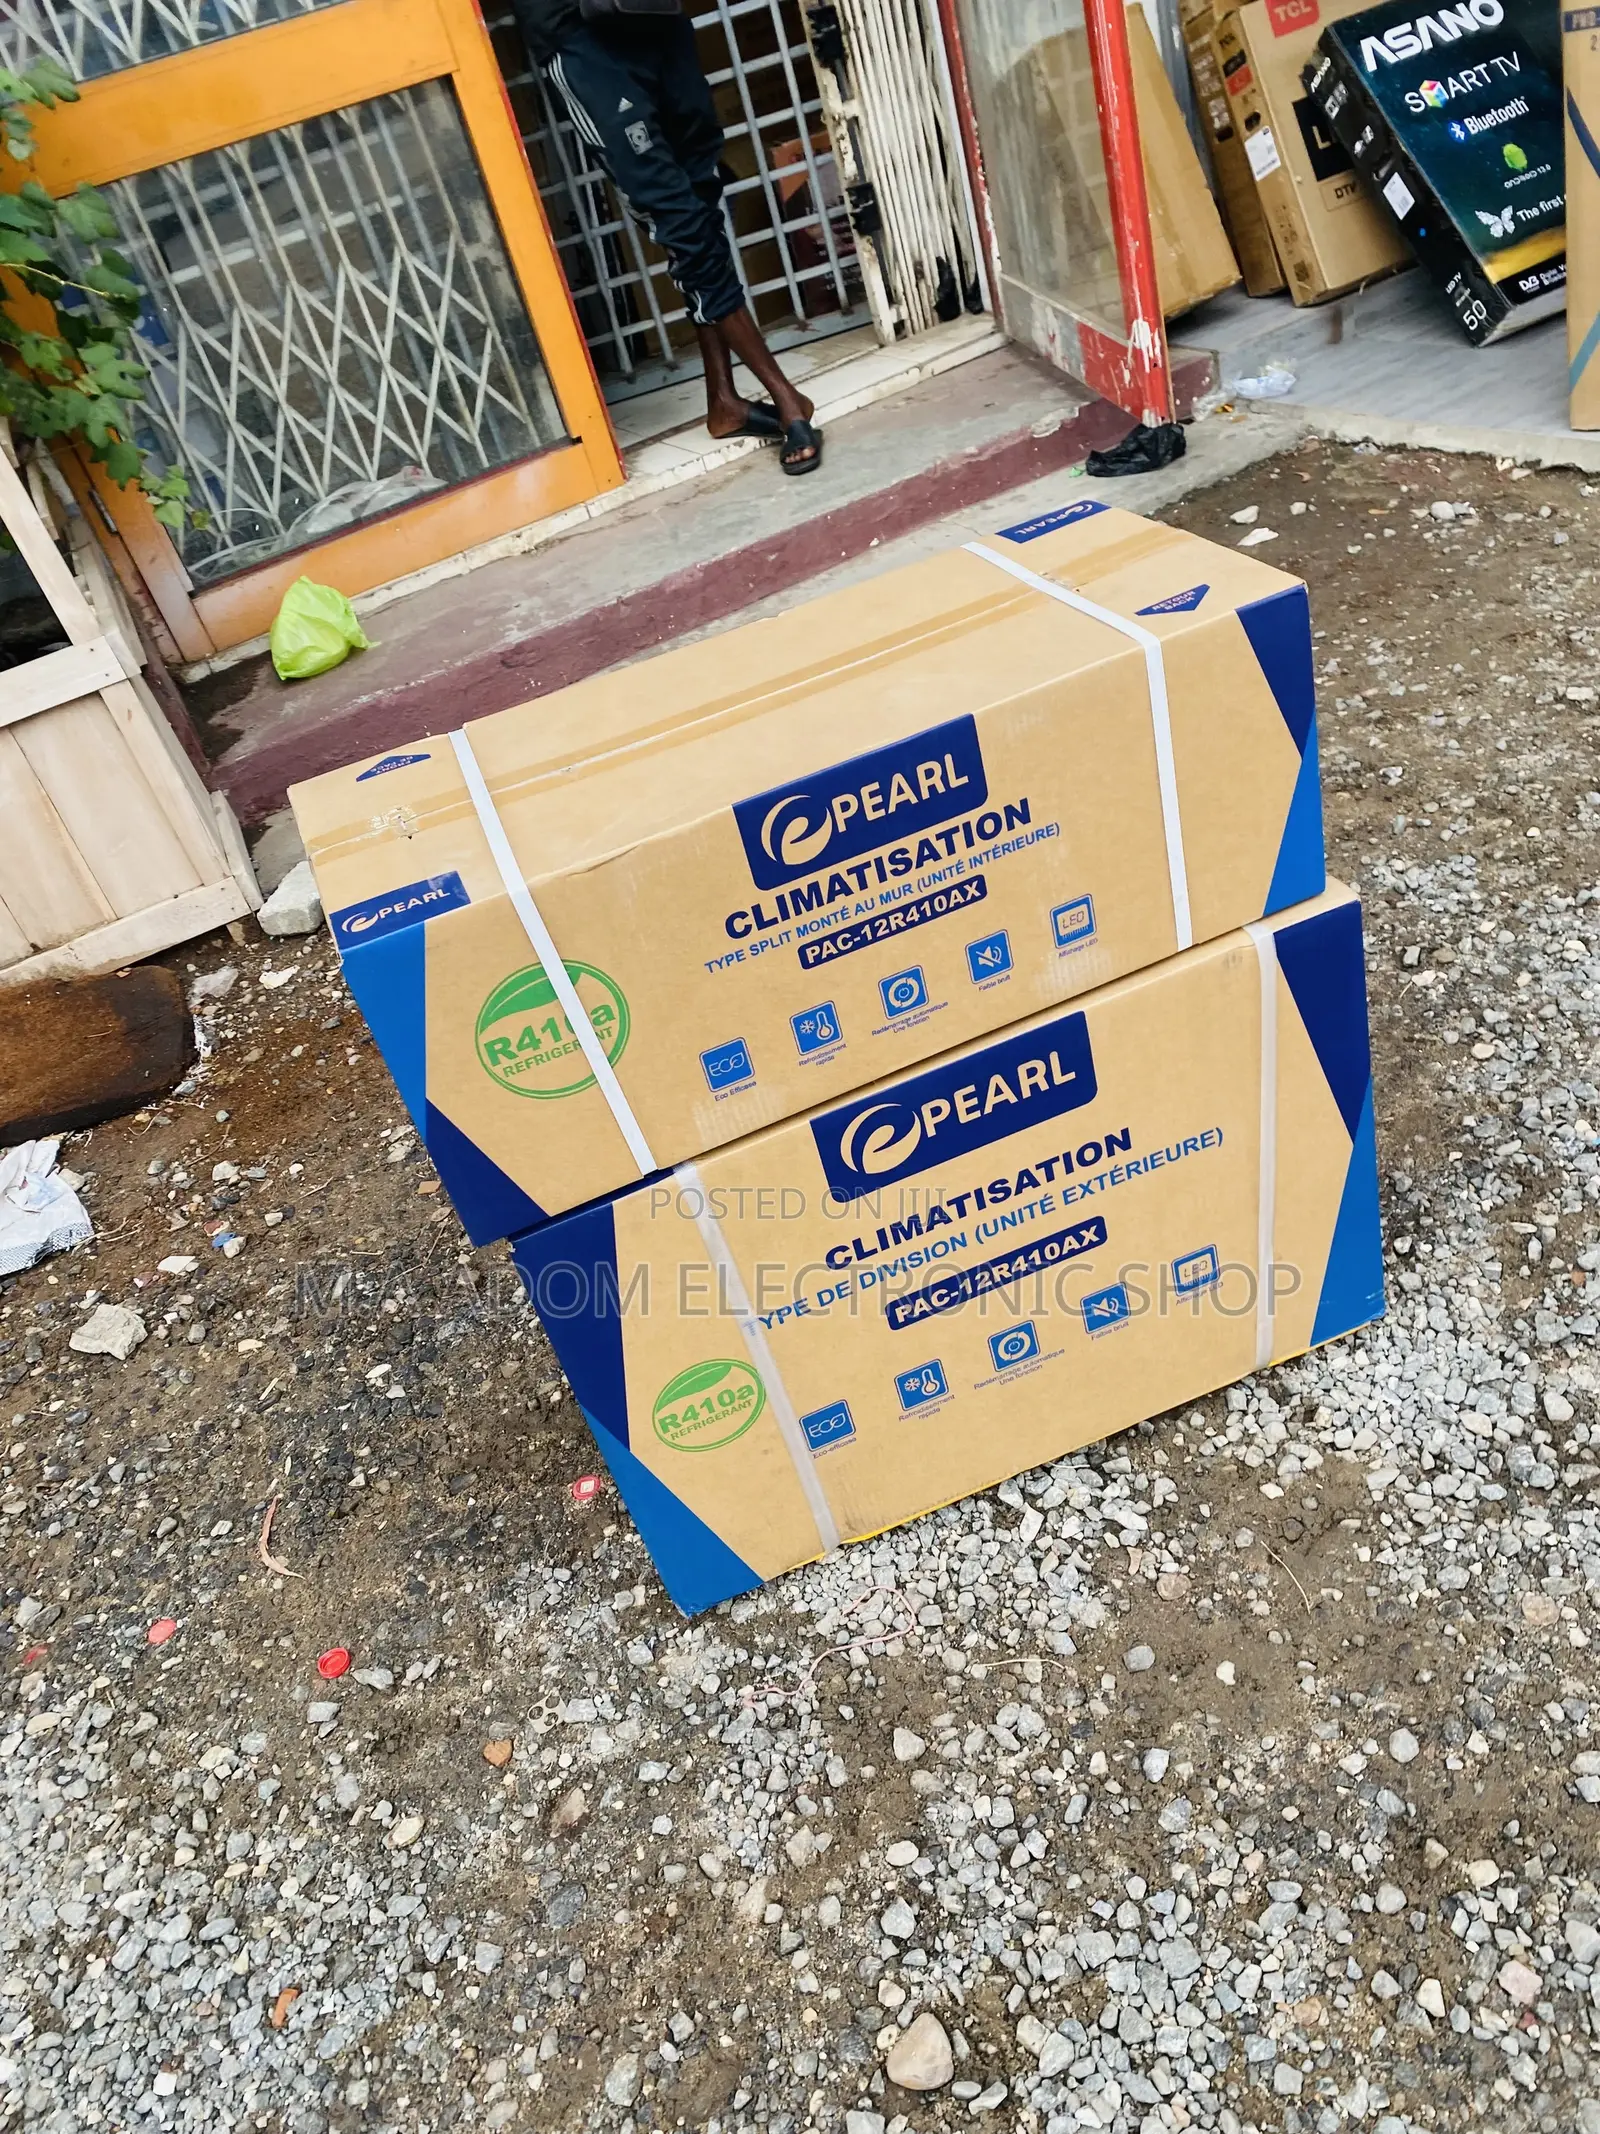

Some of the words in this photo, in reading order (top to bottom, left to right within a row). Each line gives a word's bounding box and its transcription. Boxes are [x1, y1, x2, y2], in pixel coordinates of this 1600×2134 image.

[1273, 0, 1312, 22] TCL
[1359, 0, 1504, 72] ASANO
[1490, 50, 1521, 77] TV
[1463, 96, 1530, 135] Bluetooth
[1516, 207, 1540, 222] The
[1539, 194, 1564, 212] first
[1462, 299, 1487, 331] 50
[1014, 513, 1068, 535] PEARL
[1151, 590, 1196, 611] RETOUR
[1164, 597, 1195, 611] BACK
[831, 752, 969, 834] PEARL
[724, 797, 1032, 940] CLIMATISATION
[376, 887, 451, 921] PEARL
[704, 948, 748, 975] TYPE
[749, 929, 793, 957] SPLIT
[795, 905, 851, 939] MONTÉ
[854, 894, 877, 917] AU
[879, 883, 914, 908] MUR
[916, 859, 967, 896] (UNITÉ
[968, 821, 1062, 870] INTÉRIEURE)
[804, 878, 983, 965] PAC-12R410AX
[1062, 909, 1085, 929] LED
[502, 1026, 614, 1078] REFRIGERNT
[714, 1092, 730, 1102] Eco
[923, 1049, 1077, 1140] PEARL
[825, 1127, 1133, 1272] CLIMATISATION
[816, 1279, 858, 1319] DE
[859, 1228, 968, 1296] DIVISION
[974, 1193, 1059, 1248] (UNITÉ
[1062, 1126, 1224, 1206] EXTÉRIEURE)
[894, 1225, 1102, 1325] PAC-12R410AX
[1183, 1259, 1208, 1279] LED
[1113, 1321, 1130, 1332] bruit
[659, 1381, 757, 1434] R410a
[669, 1398, 755, 1444] REFRIGERANT
